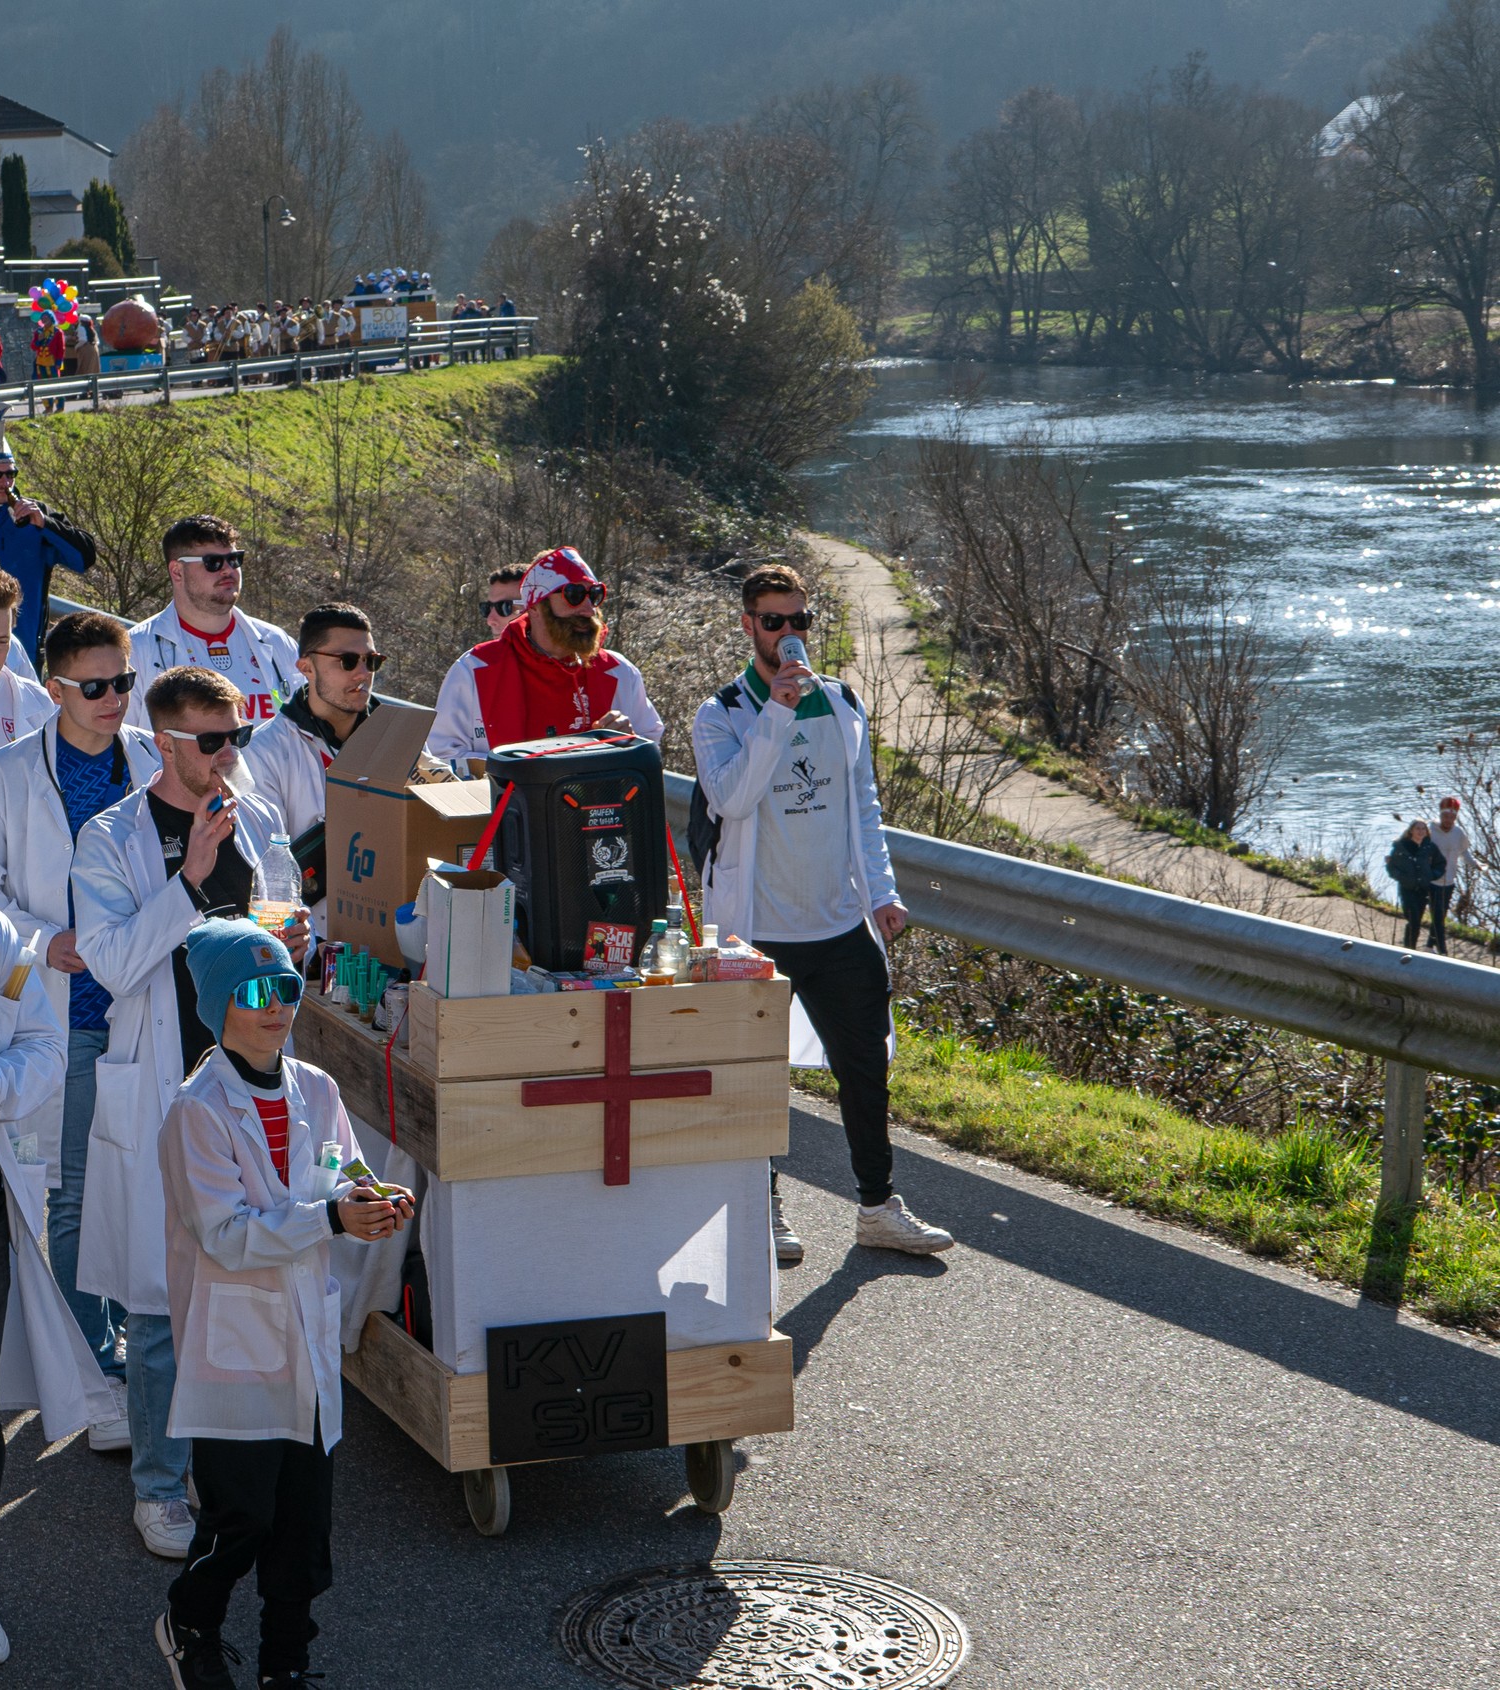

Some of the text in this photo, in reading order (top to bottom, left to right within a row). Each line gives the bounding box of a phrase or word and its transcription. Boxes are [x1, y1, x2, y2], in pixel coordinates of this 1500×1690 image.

[812, 777, 832, 788] SHOP
[589, 807, 615, 818] SAUFEN
[616, 931, 635, 948] CAS
[503, 1328, 627, 1390] KV
[532, 1390, 654, 1449] SG
